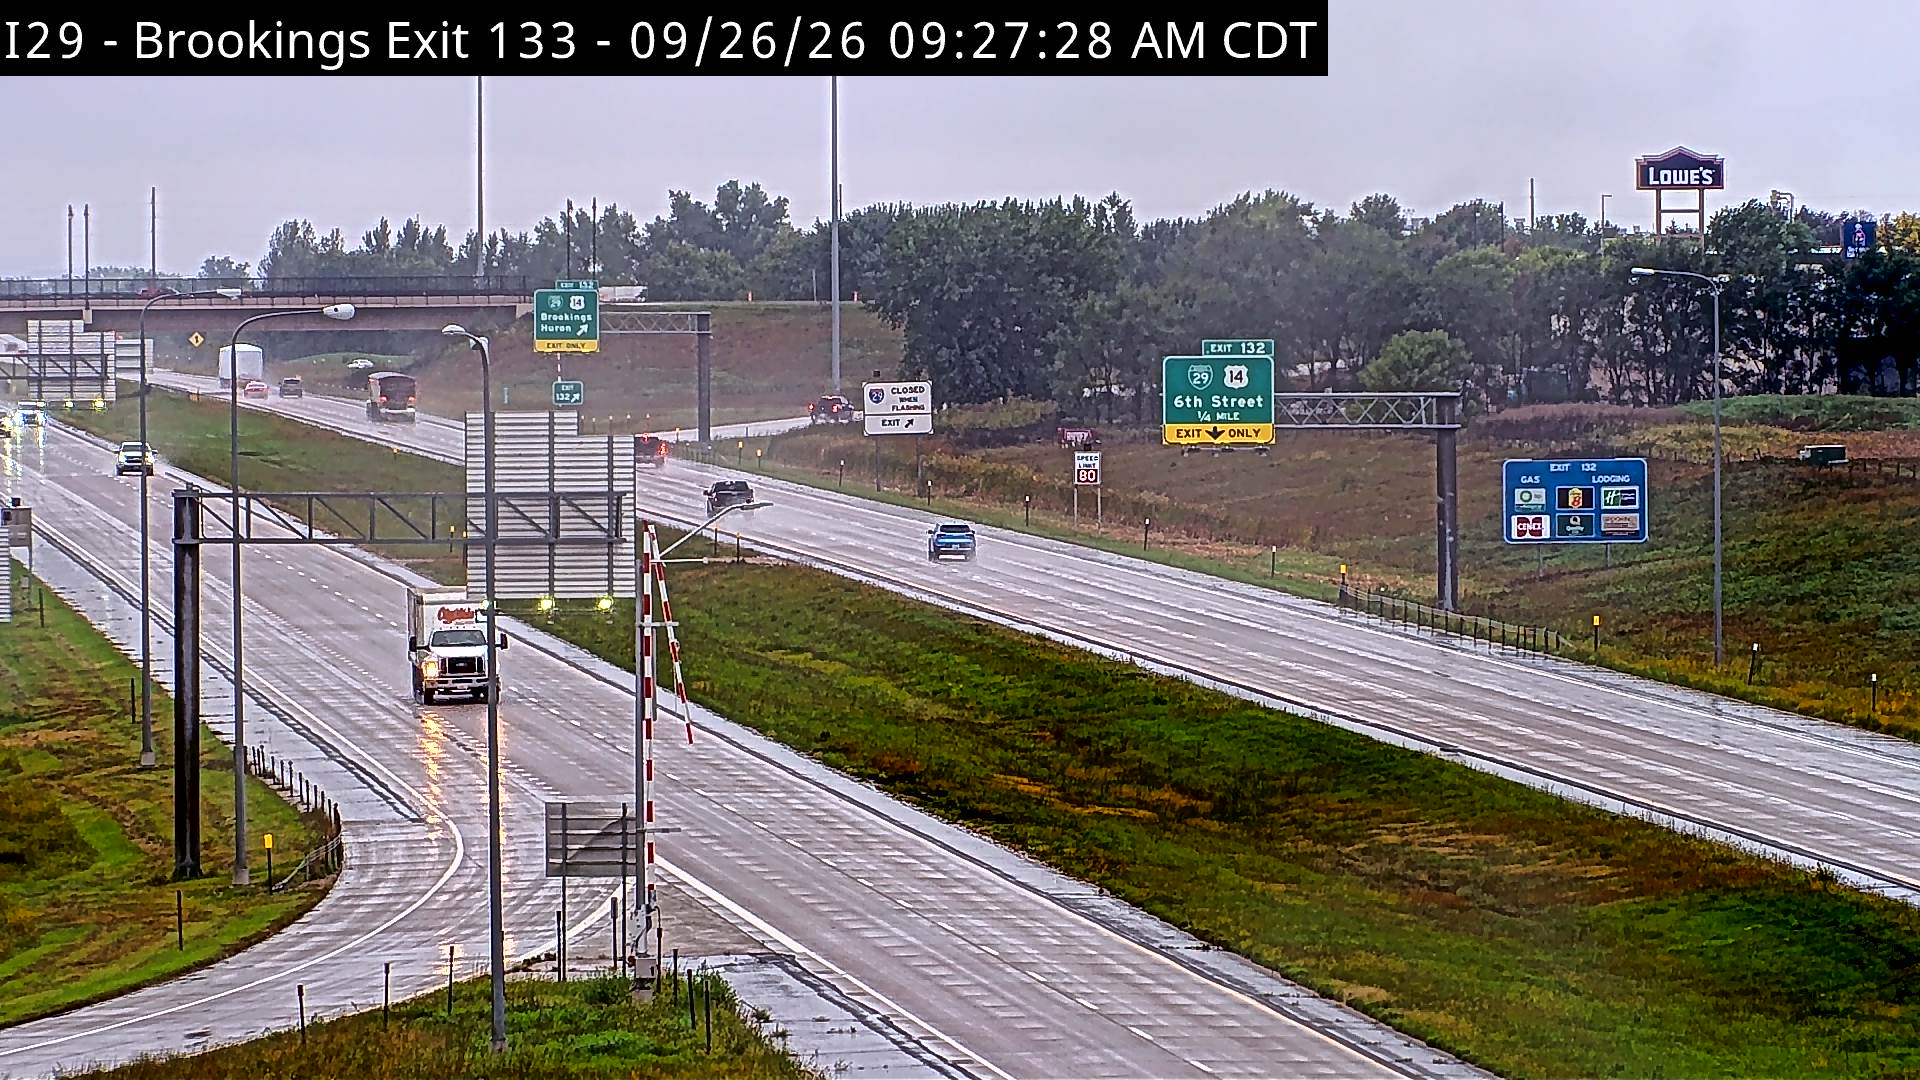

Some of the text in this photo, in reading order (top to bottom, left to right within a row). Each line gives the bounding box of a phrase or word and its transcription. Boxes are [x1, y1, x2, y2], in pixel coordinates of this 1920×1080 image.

[1648, 166, 1713, 185] LOWE'S
[572, 298, 582, 307] 14
[540, 312, 593, 323] Brookings
[540, 323, 572, 332] Huron
[1210, 342, 1266, 354] EXIT 132
[1192, 370, 1244, 385] 29 14
[891, 386, 925, 395] CLOSED
[555, 392, 570, 401] 132
[871, 391, 883, 401] 29
[1173, 395, 1264, 408] 6th Street
[1216, 412, 1240, 421] MILE
[881, 418, 901, 427] EXIT
[1176, 428, 1261, 439] EXIT ONLY
[1550, 463, 1597, 472] EXIT 132
[1079, 469, 1096, 482] 80
[1520, 475, 1541, 484] GAS
[1591, 475, 1631, 484] LODGING
